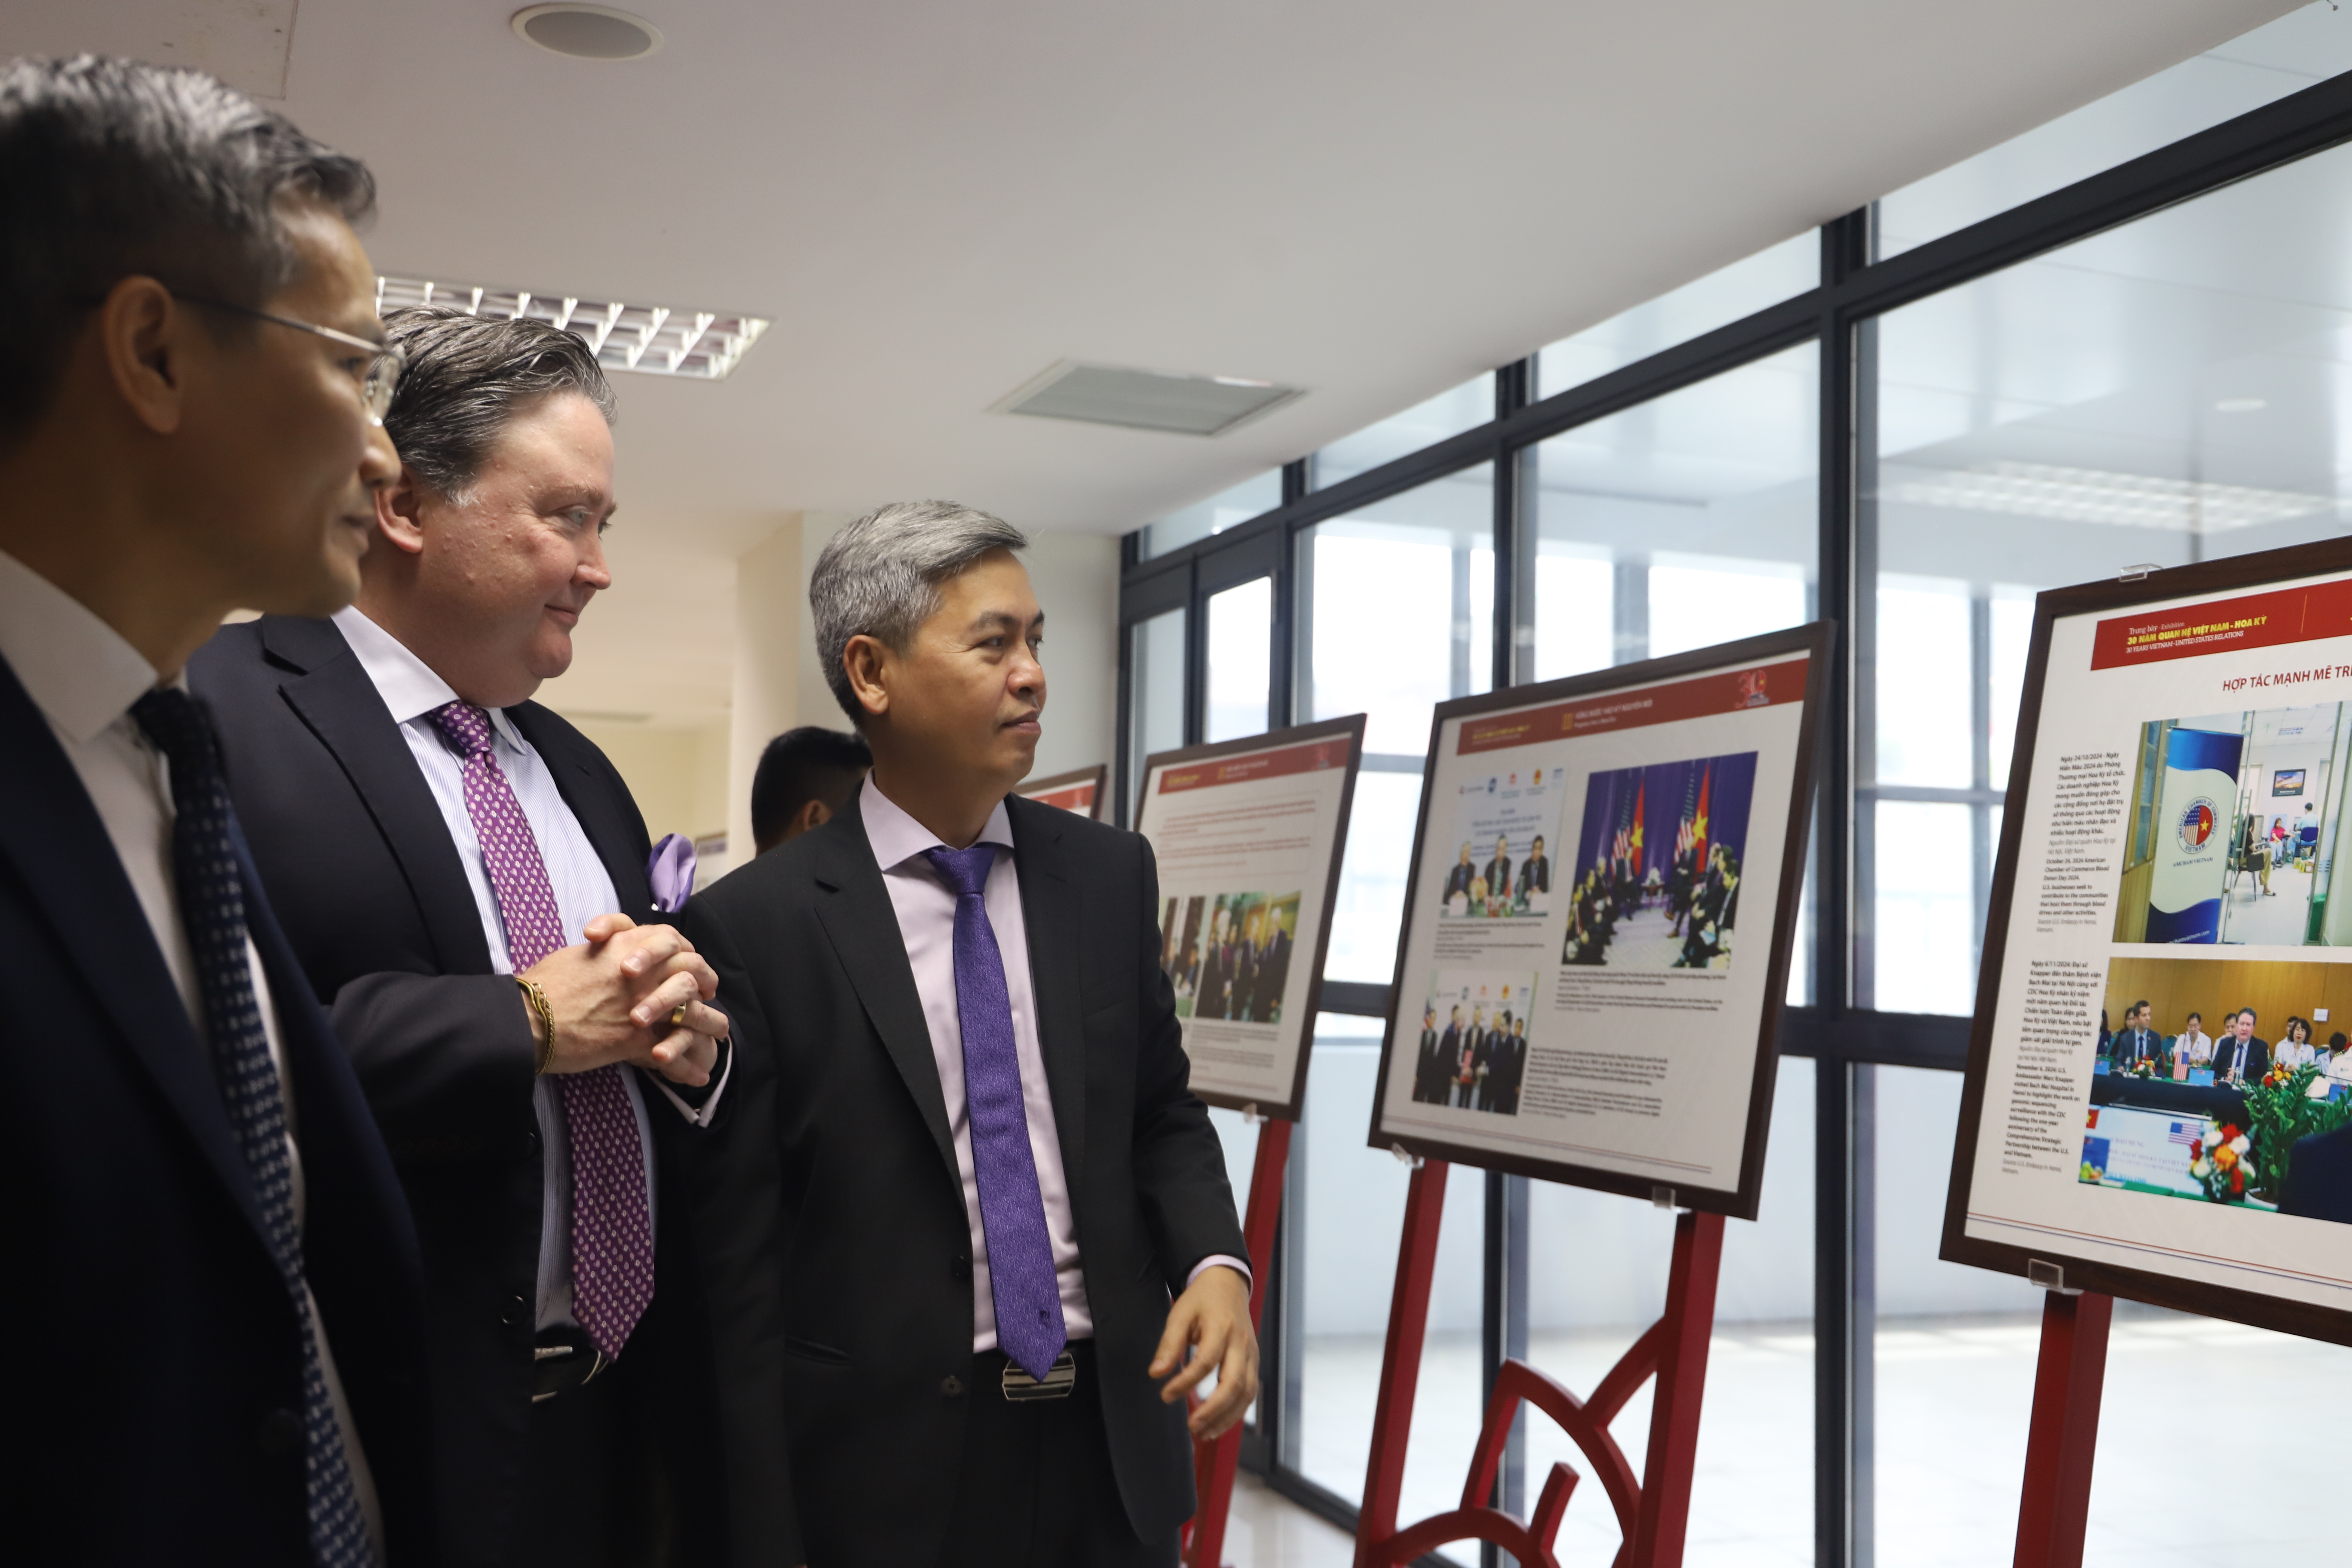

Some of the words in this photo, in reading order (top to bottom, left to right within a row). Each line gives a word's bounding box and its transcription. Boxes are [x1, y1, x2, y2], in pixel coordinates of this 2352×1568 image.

[2158, 629, 2180, 640] QUAN
[2181, 626, 2192, 638] HỆ
[2193, 624, 2210, 635] VIỆT
[2210, 622, 2230, 632] NAM
[2234, 619, 2252, 628] HOA
[2196, 635, 2214, 643] STATES
[2214, 630, 2244, 640] RELATIONS
[2223, 678, 2247, 693] HỢP
[2250, 673, 2271, 688] TÁC
[2273, 670, 2311, 687] MẠNH
[2313, 665, 2332, 680] MẼ
[2335, 665, 2352, 678] TR
[2188, 799, 2206, 810] CHAMBER
